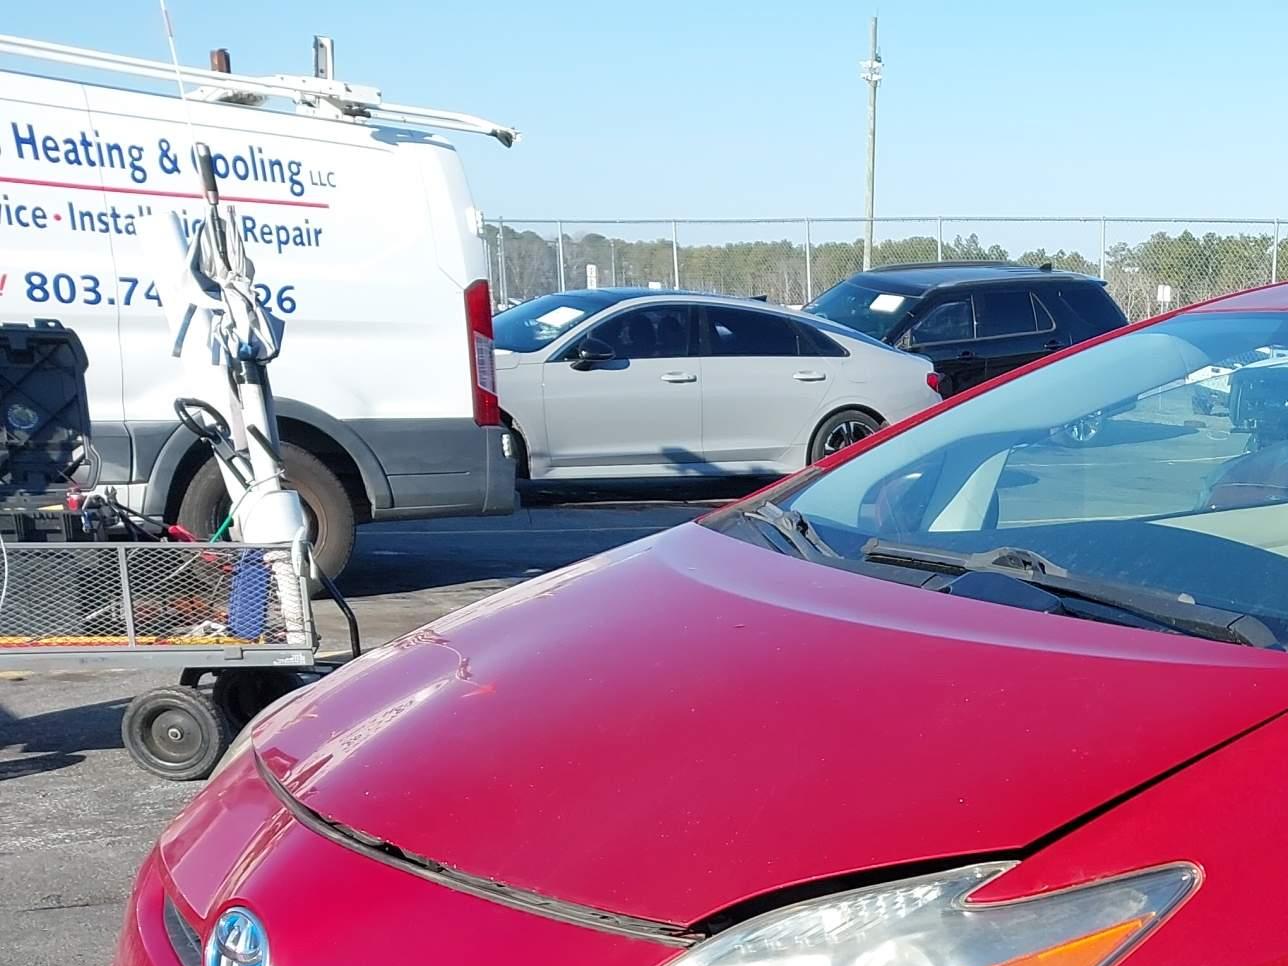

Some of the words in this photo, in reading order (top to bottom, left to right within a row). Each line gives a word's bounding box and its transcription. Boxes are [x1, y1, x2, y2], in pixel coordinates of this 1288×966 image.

[11, 122, 147, 183] Heating
[158, 138, 181, 175] &
[309, 170, 337, 188] LLC
[0, 194, 48, 229] ice
[241, 215, 323, 254] Repair
[24, 271, 297, 314] 803.7426
